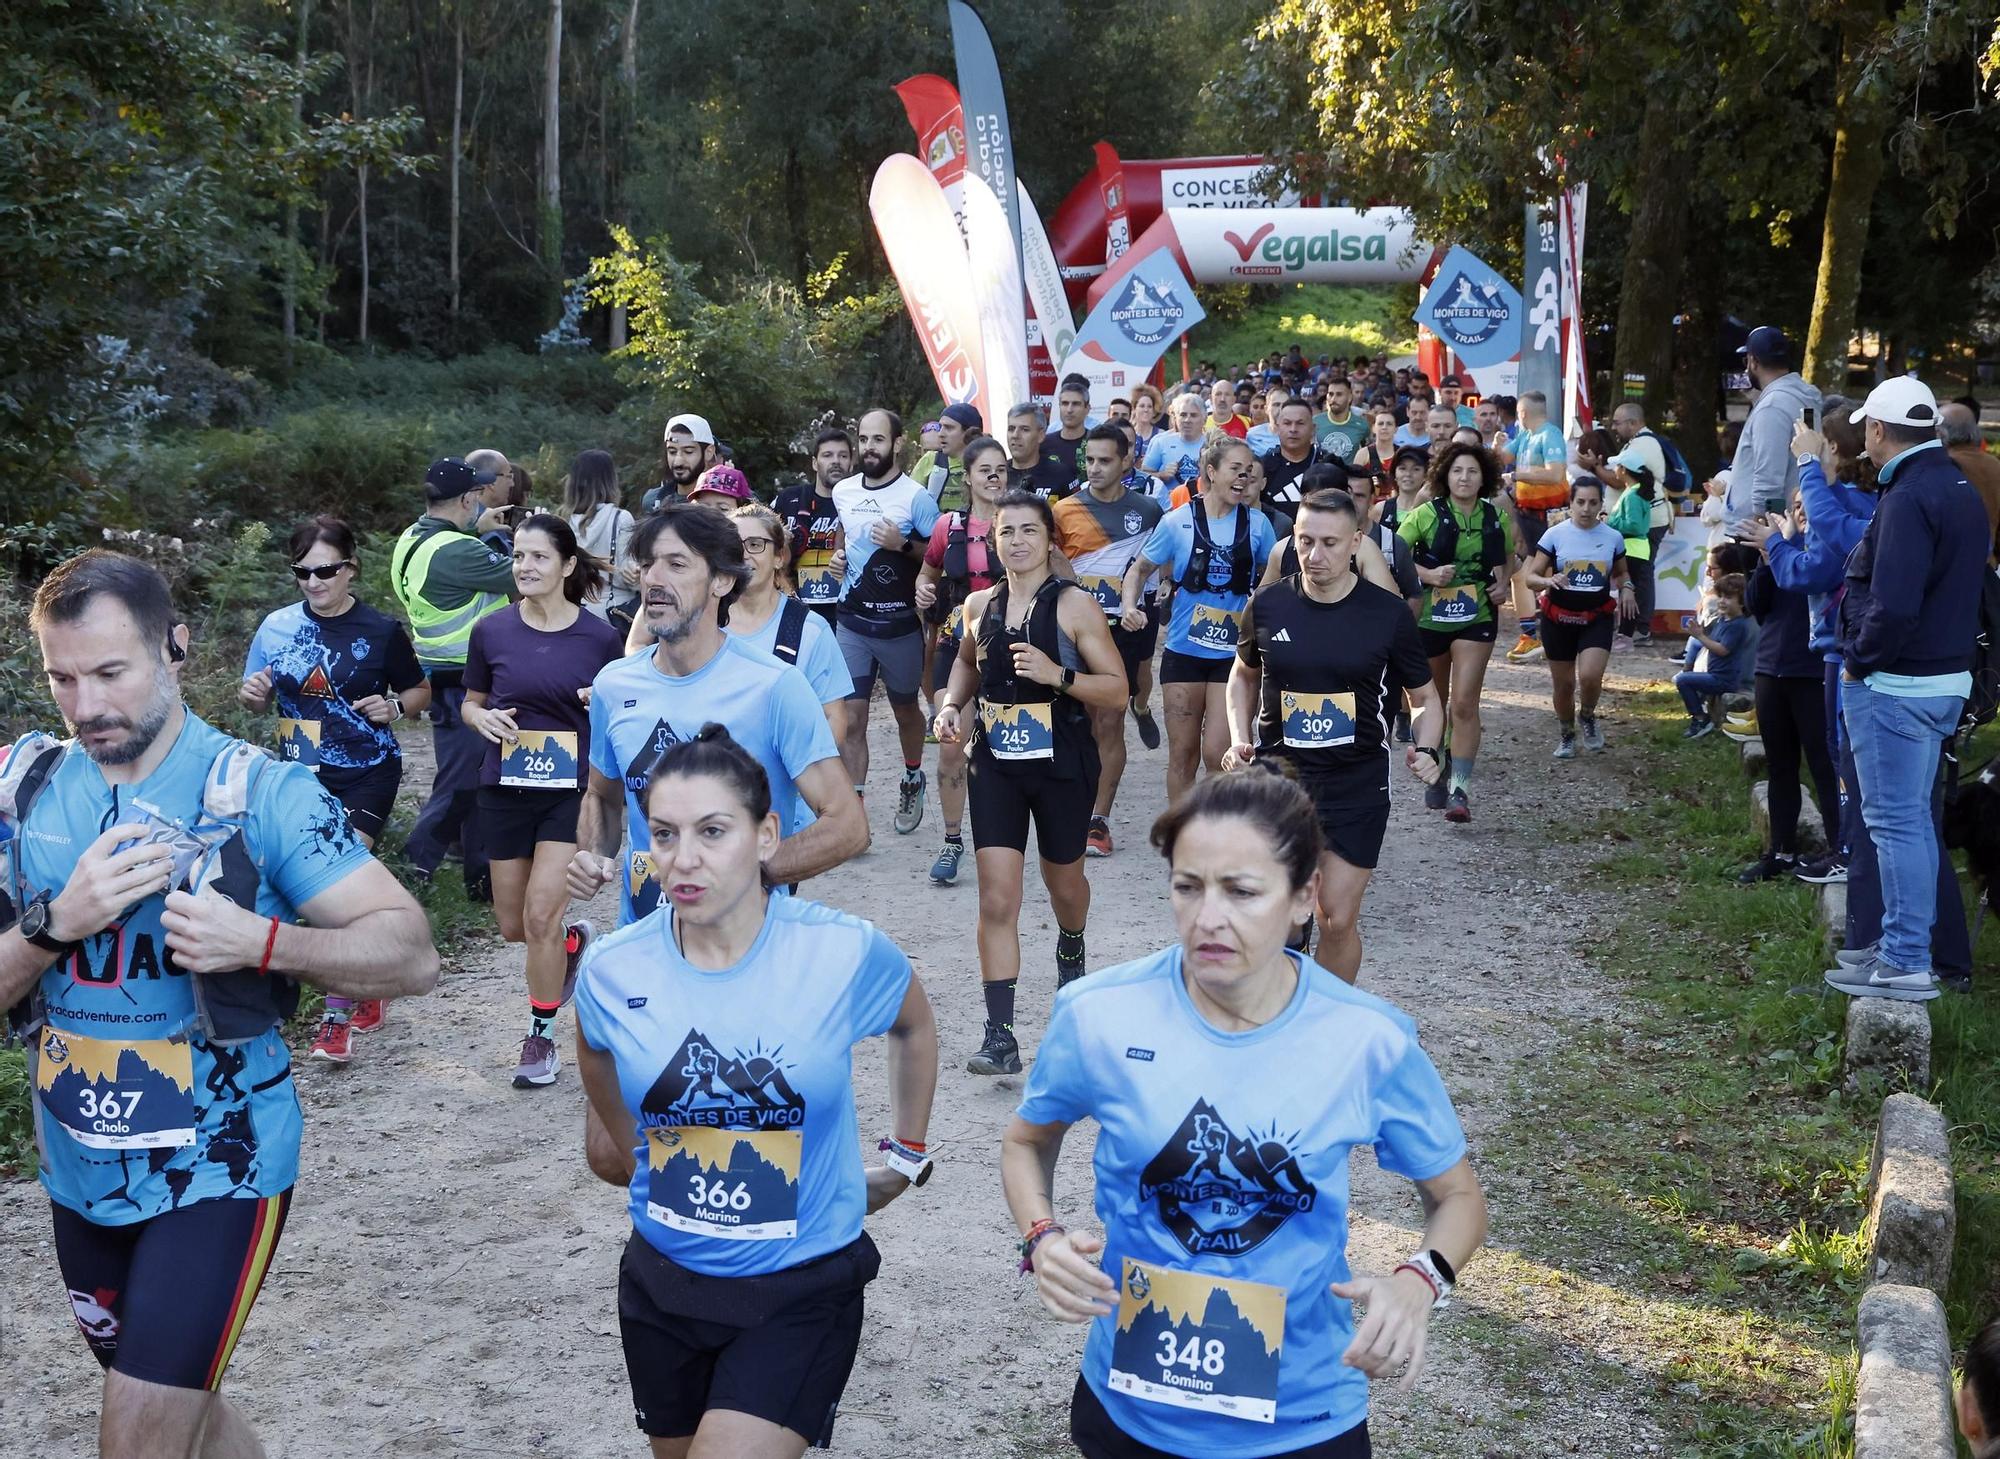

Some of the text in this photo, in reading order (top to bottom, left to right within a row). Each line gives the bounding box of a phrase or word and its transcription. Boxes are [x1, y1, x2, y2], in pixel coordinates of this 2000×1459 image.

[1173, 178, 1287, 197] CONCE
[1224, 222, 1386, 271] Vegalsa
[1244, 267, 1280, 275] EROSKI
[1112, 307, 1183, 321] MONTES DE VIGO
[1433, 308, 1508, 319] MONTES DE VIGO
[1133, 333, 1162, 343] TRAIL
[1455, 332, 1485, 344] TRAIL
[1575, 573, 1594, 583] 469
[810, 584, 830, 594] 242
[1444, 602, 1465, 613] 422
[1205, 625, 1229, 640] 370
[1302, 718, 1333, 733] 309
[1001, 729, 1030, 745] 245
[524, 756, 555, 772] 266
[528, 772, 550, 780] Raquel
[627, 776, 649, 790] MON
[79, 1088, 144, 1119] 367
[644, 1108, 801, 1127] MONTES DE VIGO
[93, 1119, 130, 1133] Cholo
[687, 1174, 752, 1210] 366
[1141, 1182, 1311, 1212] MONTES DE VIGO
[695, 1206, 741, 1223] Marina
[1186, 1227, 1251, 1251] TRAIL
[1155, 1330, 1225, 1376] 348
[1162, 1369, 1214, 1392] Romina
